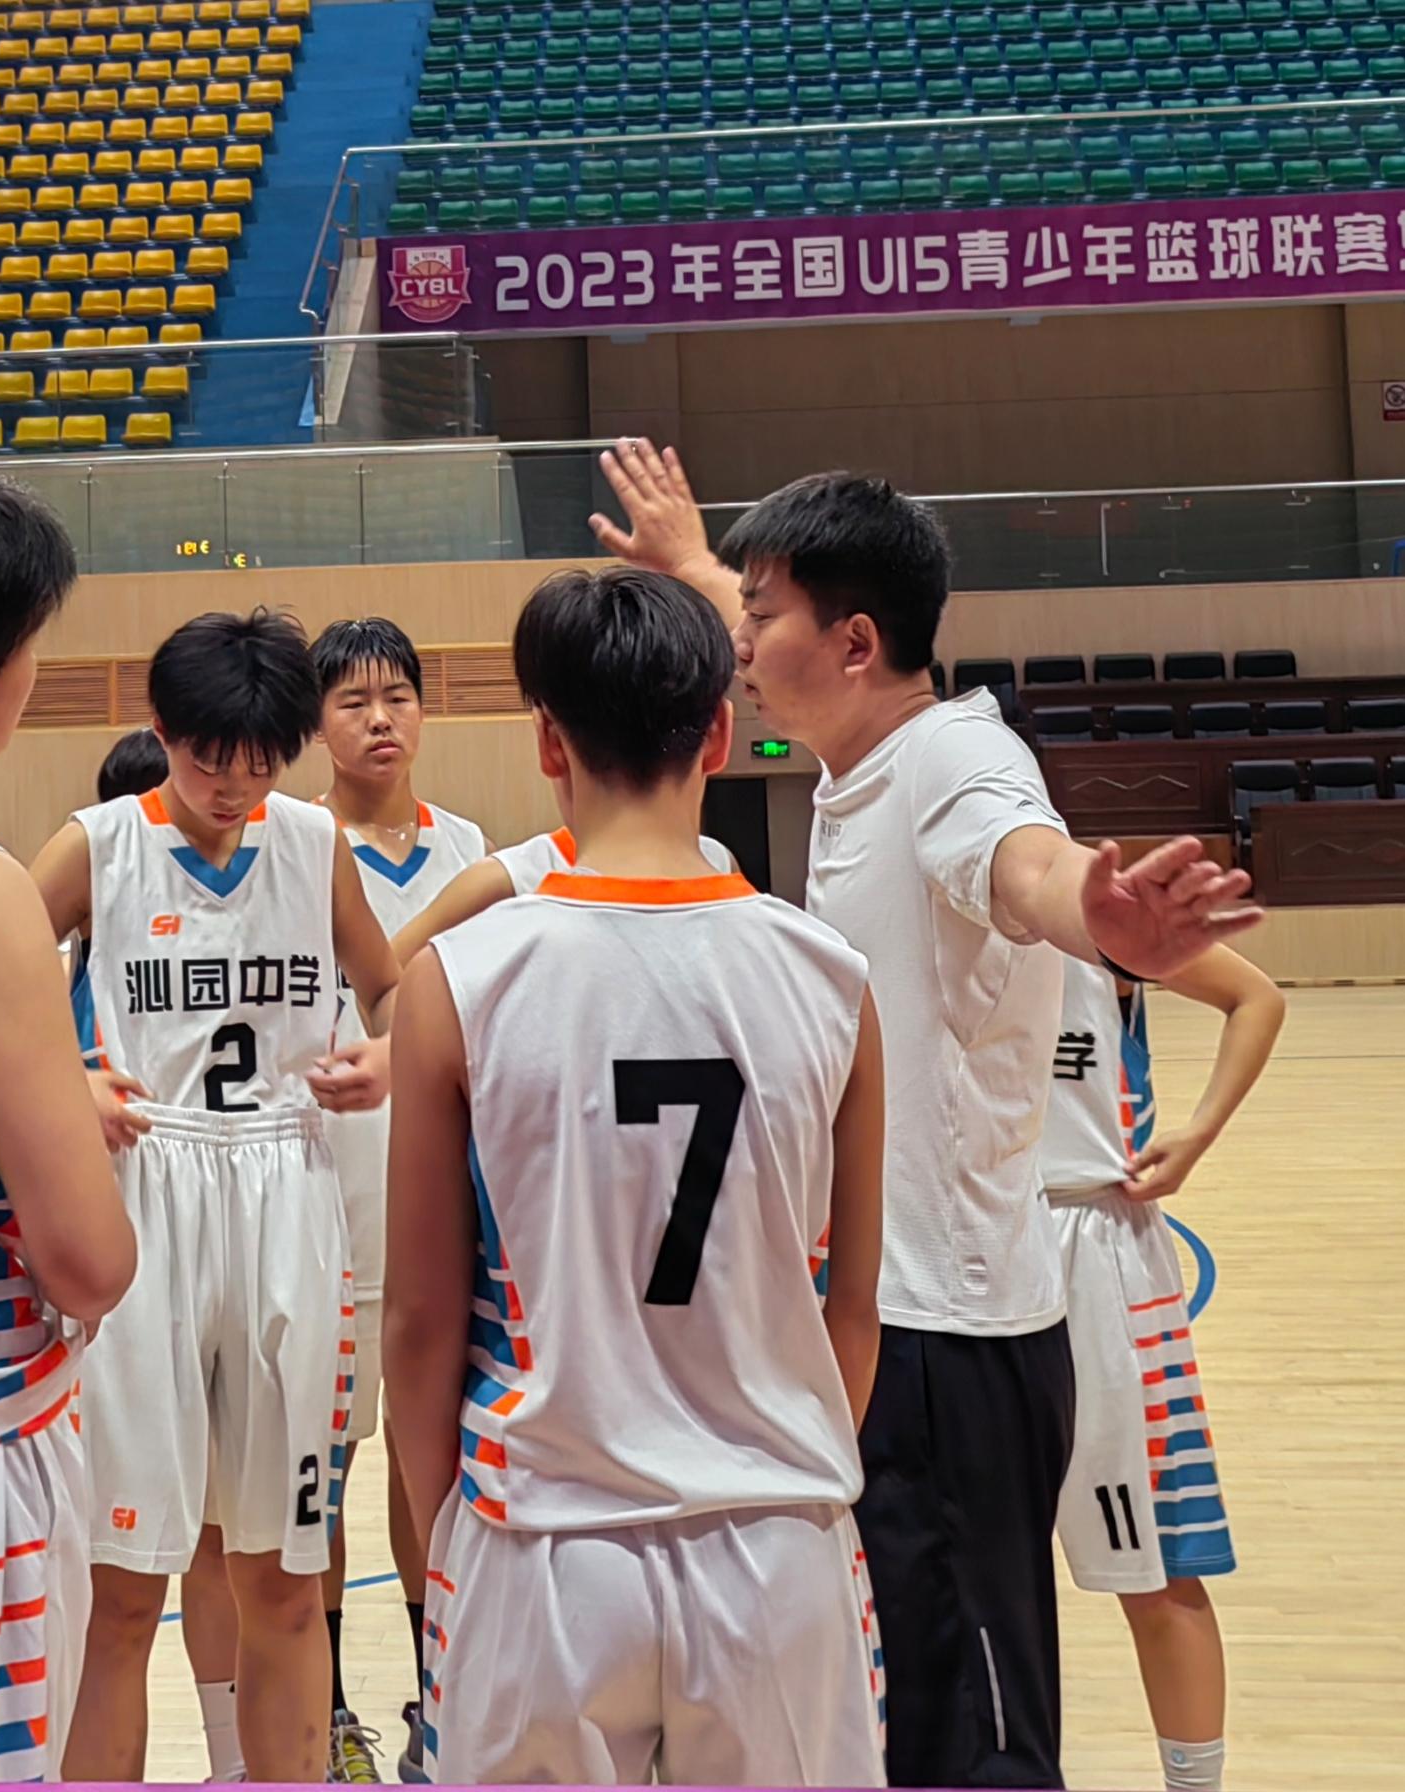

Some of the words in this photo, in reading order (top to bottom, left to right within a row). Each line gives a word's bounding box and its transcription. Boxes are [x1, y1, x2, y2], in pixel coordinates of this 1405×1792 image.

[400, 277, 461, 296] CYBL
[495, 209, 1405, 312] 2023年全国U15青少年篮球联赛
[125, 954, 321, 1014] 沁园中学
[204, 1022, 260, 1113] 2
[612, 1058, 746, 1305] 7
[296, 1454, 321, 1526] 2
[1095, 1484, 1141, 1550] 11
